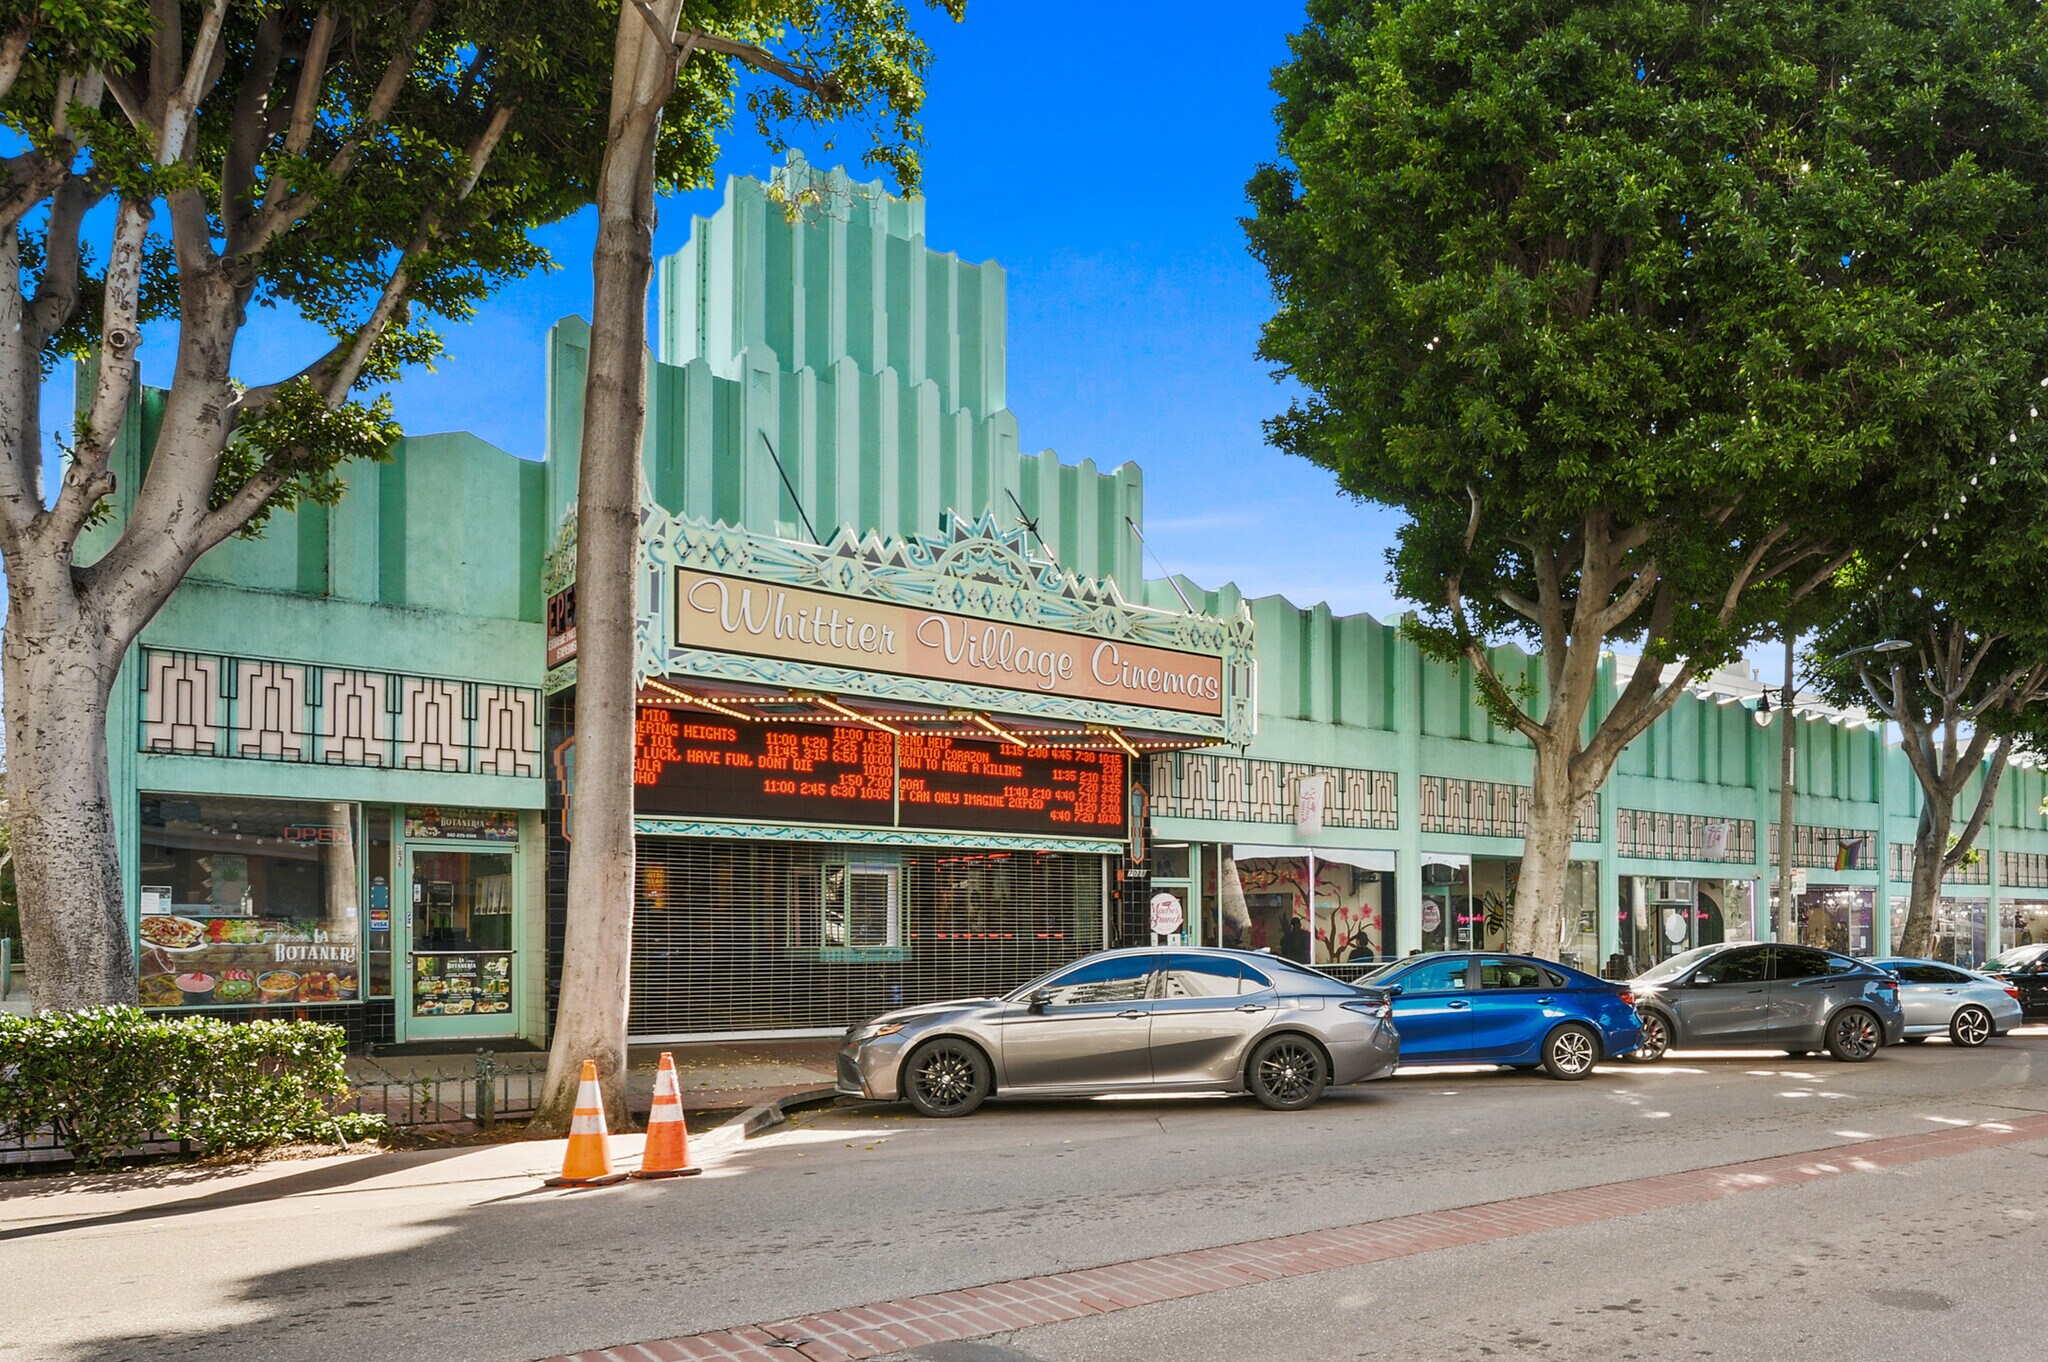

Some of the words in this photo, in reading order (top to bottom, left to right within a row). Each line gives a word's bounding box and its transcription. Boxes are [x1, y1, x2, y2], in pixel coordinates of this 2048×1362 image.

[688, 578, 896, 654] Whittier
[916, 615, 1073, 690] Village
[1091, 641, 1218, 700] Cinemas
[642, 708, 669, 722] MIO
[834, 727, 863, 741] 11:00
[868, 730, 892, 743] 4:30
[650, 734, 674, 748] 101
[767, 745, 798, 759] 11:45
[803, 748, 828, 761] 3:15
[832, 750, 858, 763] 6:50
[862, 753, 892, 765] 10:00
[684, 724, 736, 741] HEIGHTS
[766, 732, 797, 746] 11:00
[802, 736, 828, 749] 4:20
[833, 739, 858, 751] 7:25
[862, 741, 892, 754] 10:20
[898, 735, 924, 747] SEND
[927, 737, 952, 749] HELP
[1000, 743, 1025, 756] 11:15
[1027, 747, 1049, 759] 2:00
[1051, 749, 1074, 761] 4:45
[1075, 751, 1097, 763] 7:30
[1098, 753, 1121, 765] 10:15
[644, 746, 683, 761] LUCK,
[687, 749, 720, 765] HAVE
[725, 752, 754, 768] FUN,
[758, 755, 787, 769] DONT
[793, 758, 814, 771] DIE
[863, 765, 893, 777] 10:00
[898, 745, 941, 760] BENDITO
[944, 750, 990, 763] CORAZON
[1102, 764, 1122, 775] 2:05
[899, 756, 921, 770] HOW
[926, 758, 938, 771] TO
[942, 760, 969, 773] MAKE
[972, 762, 980, 774] A
[983, 763, 1023, 778] KILLING
[1052, 769, 1077, 781] 11:35
[1079, 772, 1099, 783] 2:10
[764, 780, 797, 794] 11:00
[800, 782, 826, 796] 2:45
[831, 785, 857, 798] 6:30
[860, 786, 890, 800] 10:05
[839, 773, 863, 786] 1:50
[868, 776, 892, 788] 7:00
[899, 778, 926, 791] GOAT
[1003, 786, 1029, 798] 11:40
[1031, 788, 1053, 800] 2:10
[1055, 790, 1076, 802] 4:40
[1078, 792, 1098, 803] 7:10
[1079, 782, 1099, 793] 7:20
[899, 789, 905, 801] I
[909, 791, 930, 803] CAN
[934, 792, 960, 805] ONLY
[963, 794, 1005, 808] IMAGINE
[1074, 801, 1098, 814] 11:20
[1101, 804, 1120, 815] 2:00
[1050, 809, 1073, 821] 4:40
[1074, 811, 1095, 823] 7:20
[1097, 813, 1121, 825] 10:00
[284, 826, 348, 842] OPEN
[314, 928, 329, 943] LA
